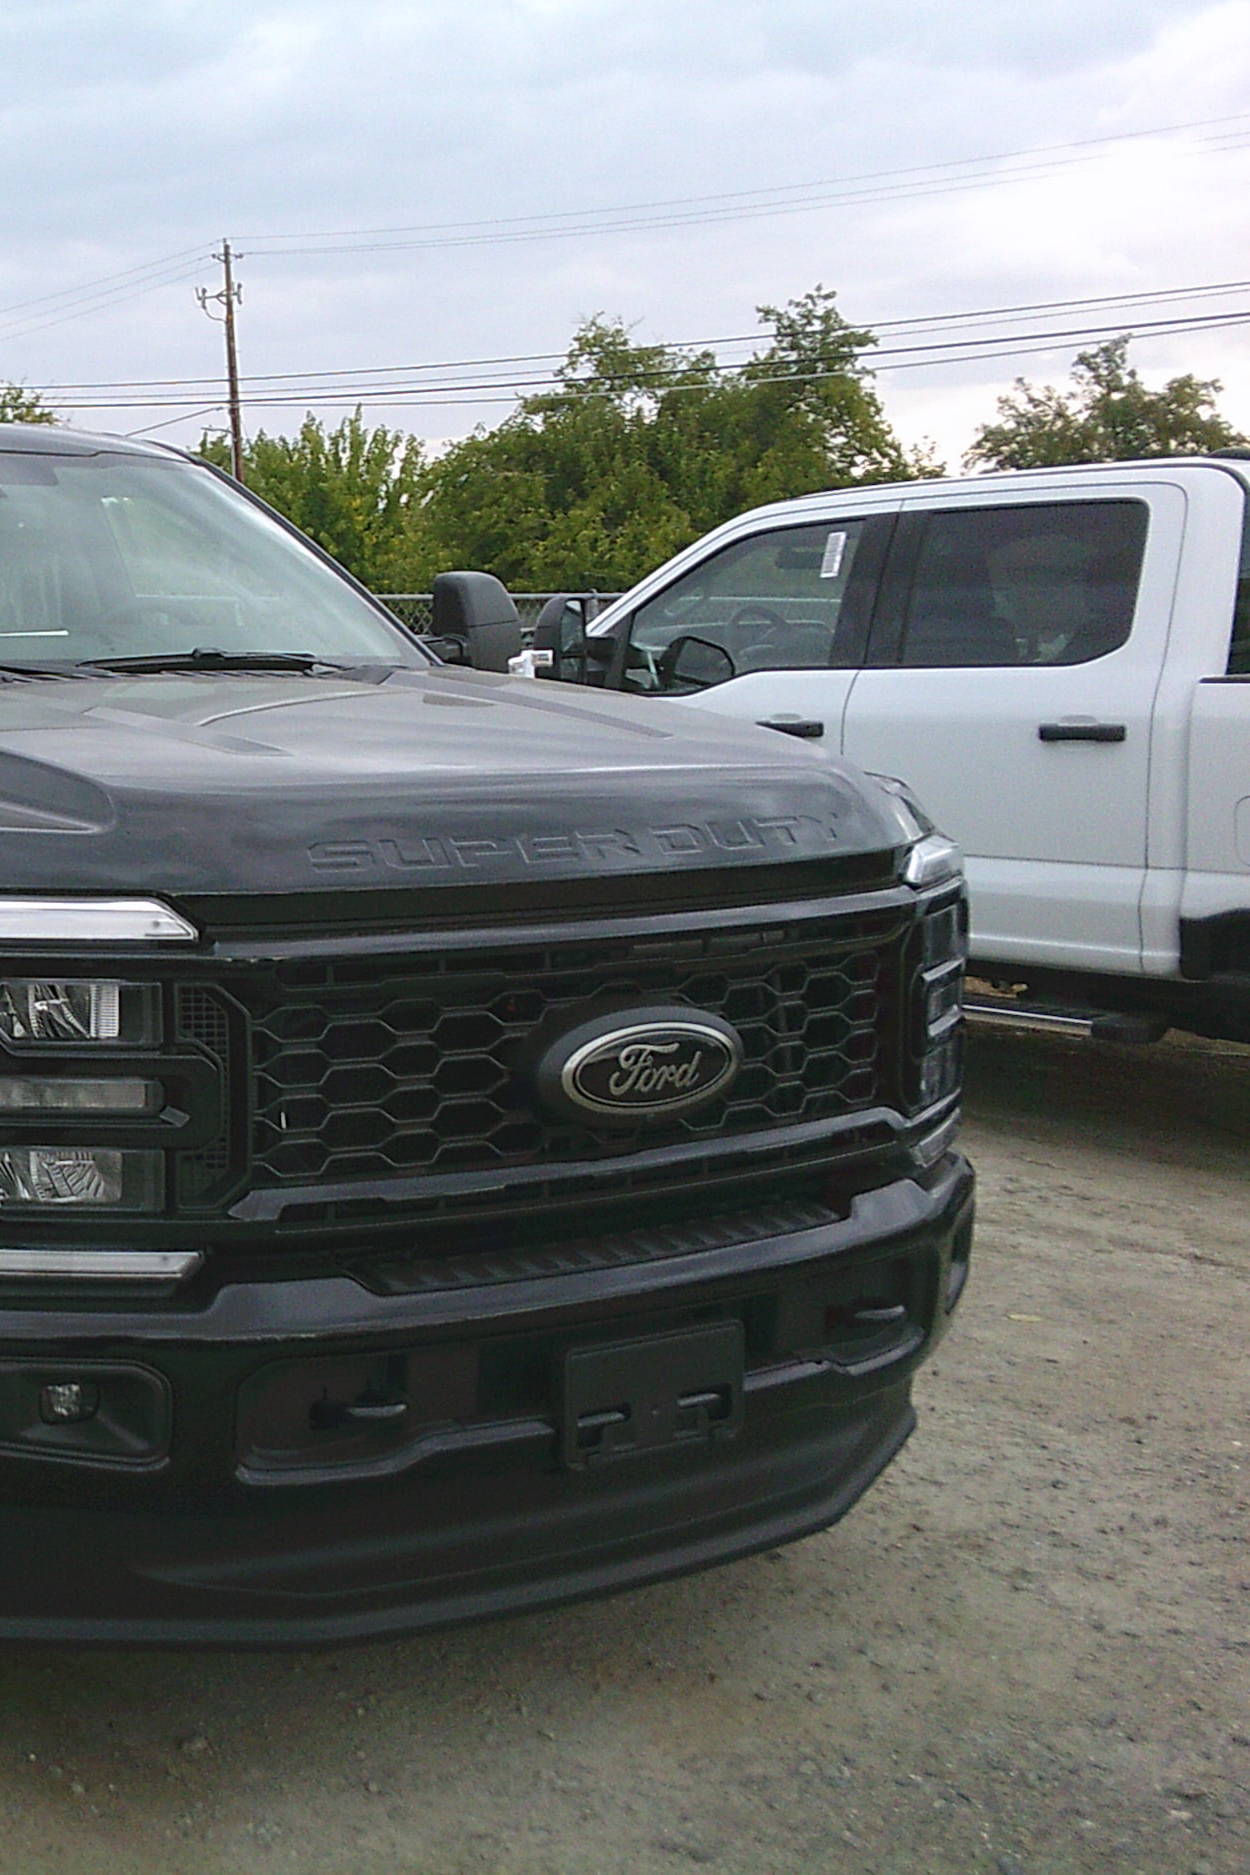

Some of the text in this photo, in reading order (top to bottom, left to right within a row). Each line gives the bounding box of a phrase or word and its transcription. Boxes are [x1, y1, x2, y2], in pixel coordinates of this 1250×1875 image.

[306, 811, 840, 873] SUPER DUTY
[609, 1042, 702, 1096] Ford
